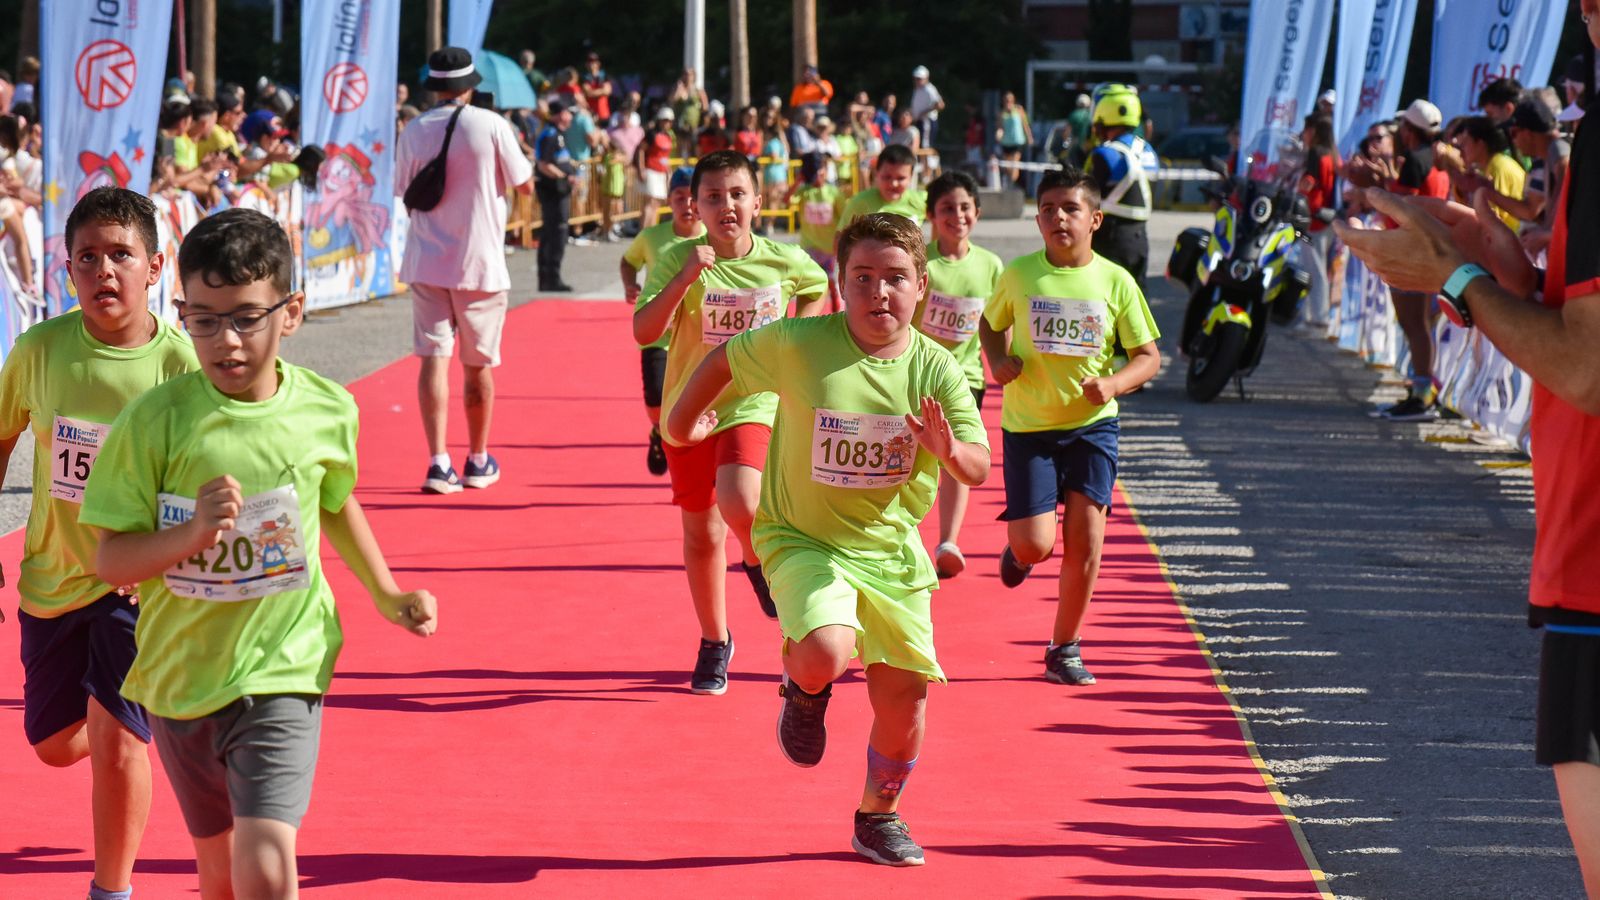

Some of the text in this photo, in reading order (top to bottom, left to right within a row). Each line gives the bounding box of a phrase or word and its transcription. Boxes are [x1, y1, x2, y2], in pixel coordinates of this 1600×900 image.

[708, 309, 757, 330] 1487
[929, 307, 966, 329] 1106
[1033, 316, 1080, 339] 1495
[57, 424, 98, 440] XXI Carrera
[820, 416, 859, 429] XXI Carrera
[77, 435, 98, 444] Popular
[820, 437, 884, 468] 1083
[58, 448, 97, 481] 15
[163, 504, 184, 522] XXI
[177, 536, 254, 573] 420
